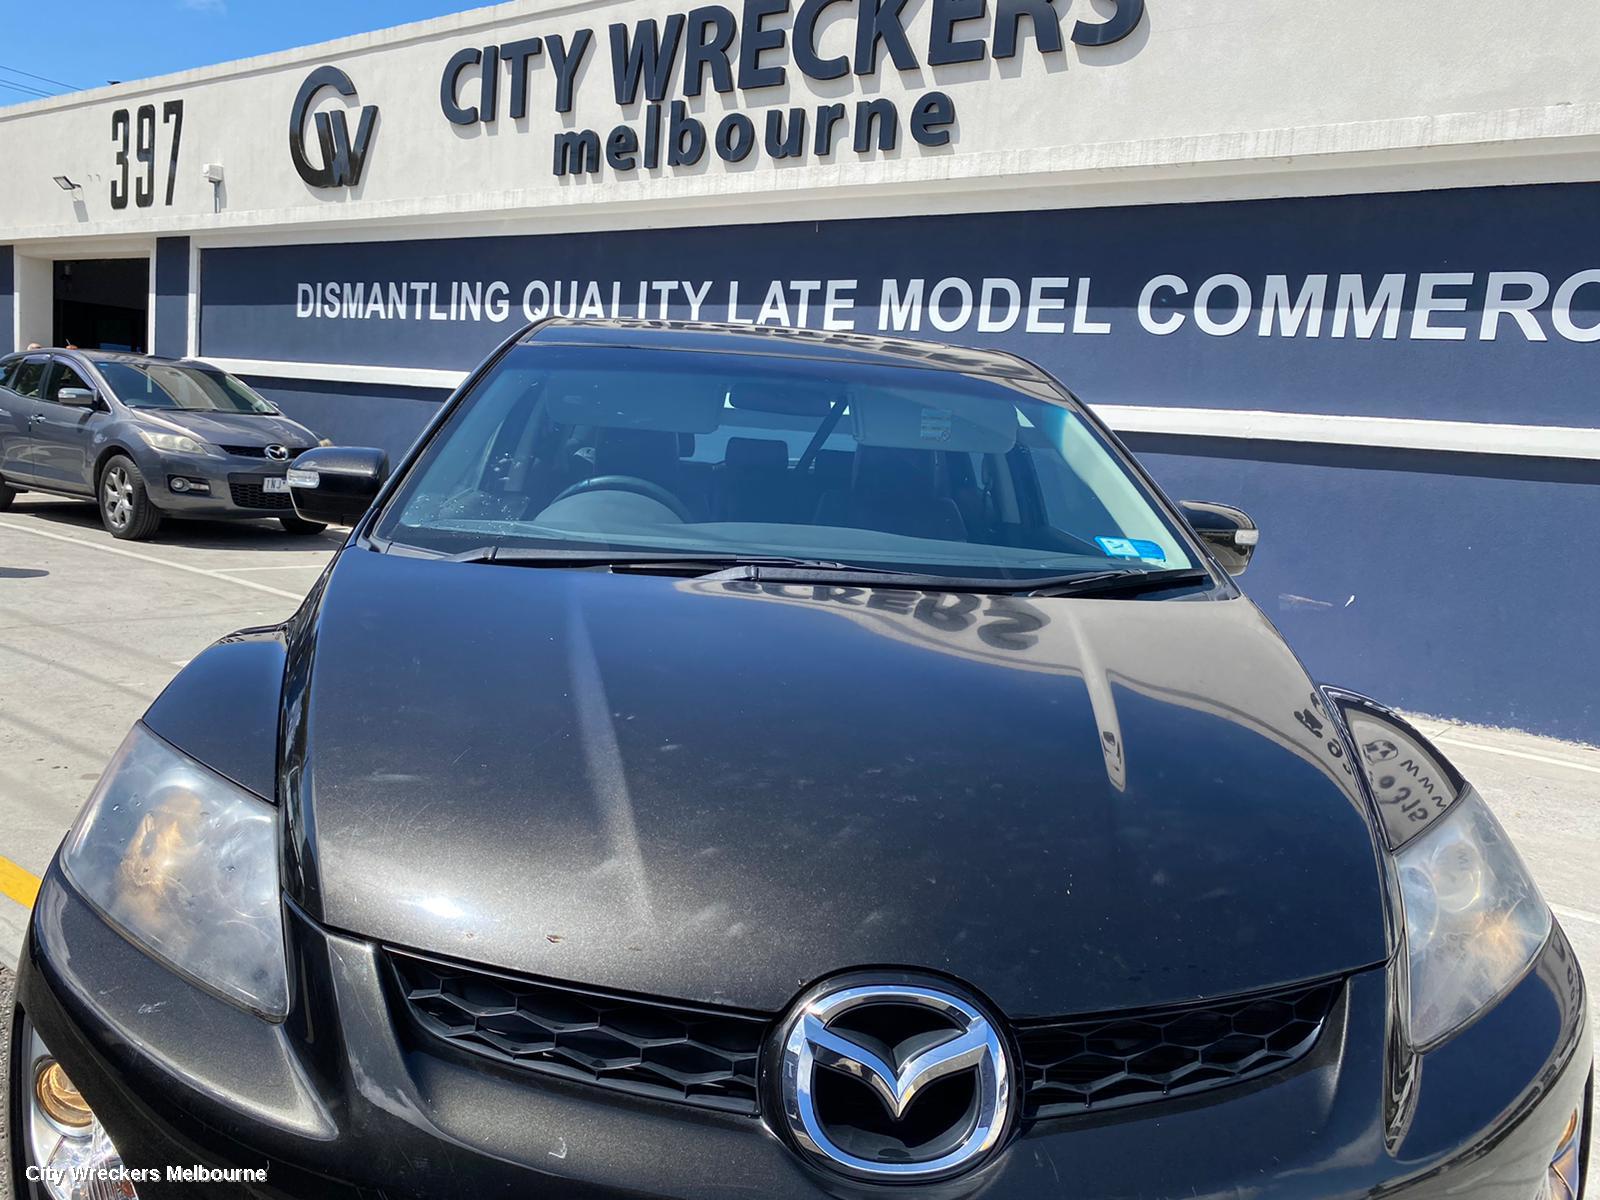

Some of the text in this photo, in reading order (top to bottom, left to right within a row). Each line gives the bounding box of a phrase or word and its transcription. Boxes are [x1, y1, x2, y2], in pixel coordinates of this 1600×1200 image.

[441, 28, 592, 125] CITY
[110, 99, 184, 210] 397
[553, 92, 955, 176] melbourne
[296, 281, 510, 322] DISMANTLING
[522, 280, 713, 323] QUALITY
[727, 279, 858, 331] LATE
[878, 277, 1111, 334] MODEL
